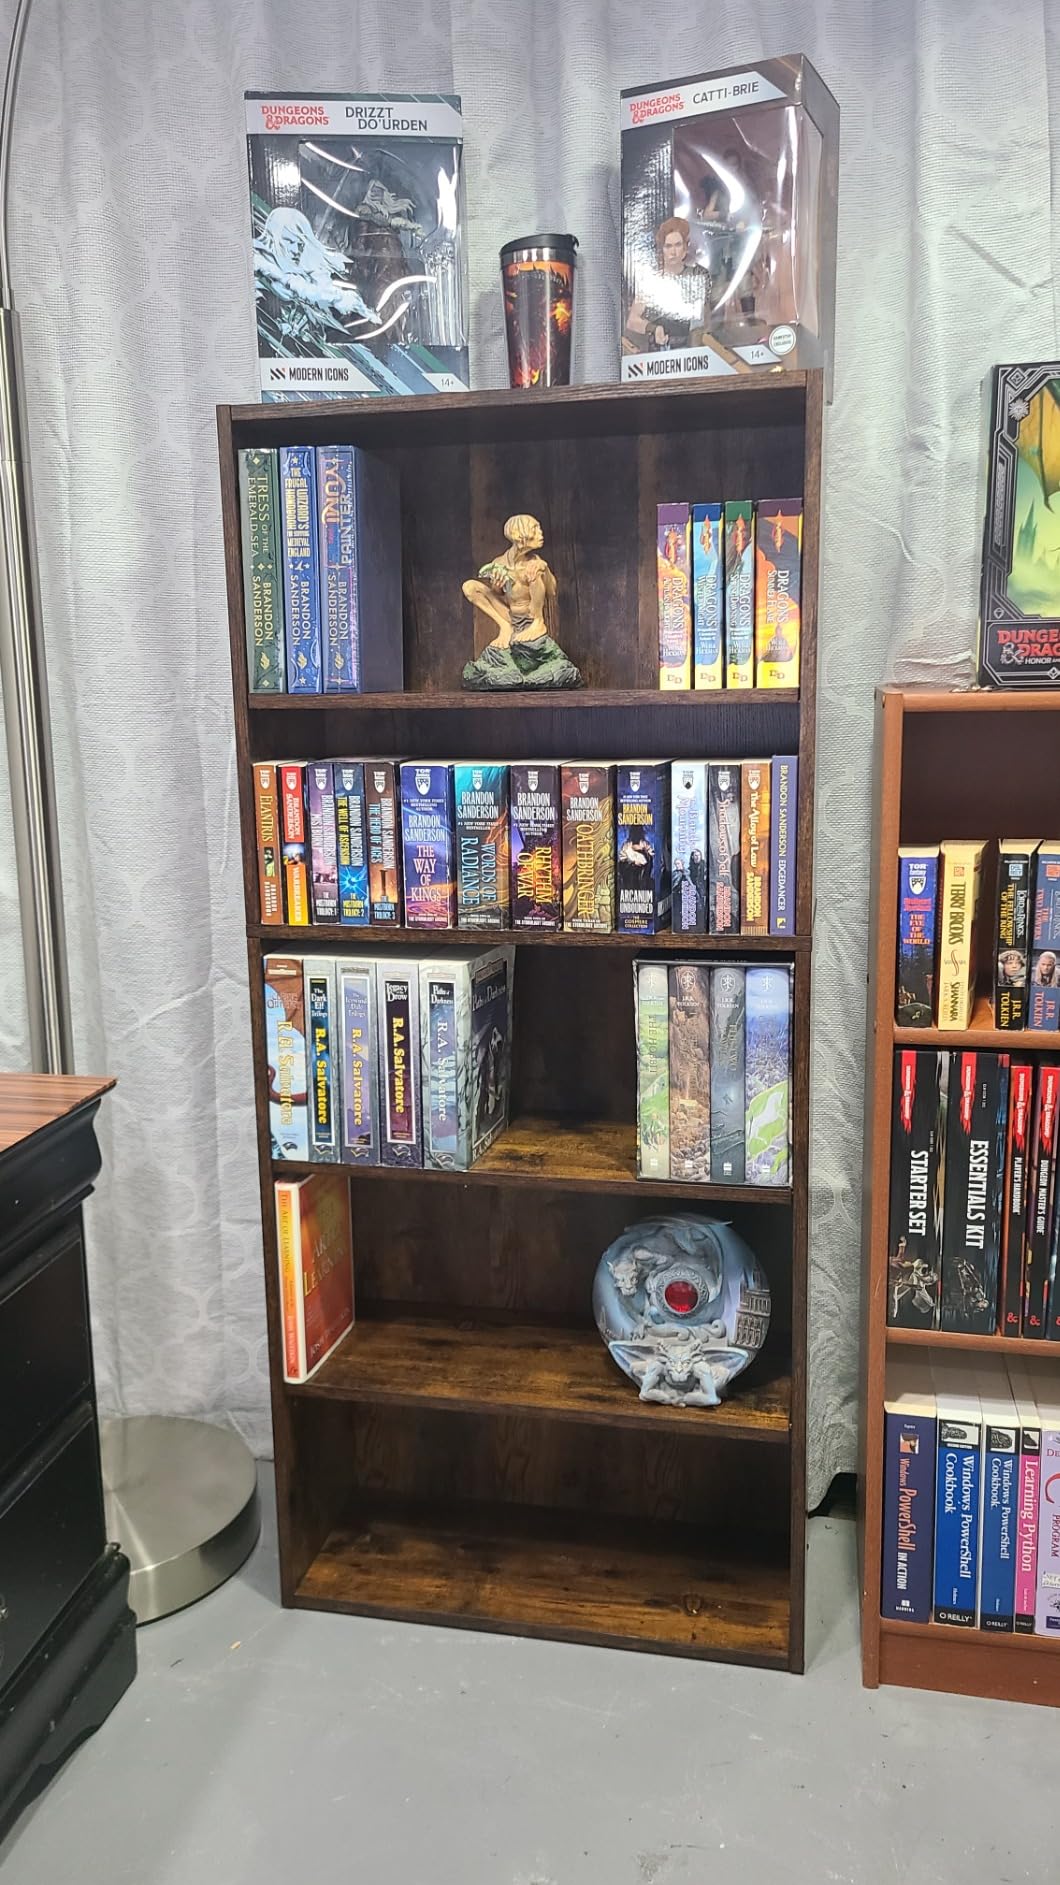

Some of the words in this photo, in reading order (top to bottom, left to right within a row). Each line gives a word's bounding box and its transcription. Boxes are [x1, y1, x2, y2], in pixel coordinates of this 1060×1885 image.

[629, 93, 681, 112] DUNGEONS
[693, 81, 760, 105] CATTI-BRIE
[261, 105, 325, 116] DUNGEONS
[345, 107, 394, 119] DRIZZT
[358, 118, 428, 131] DO'URDEN
[289, 367, 322, 381] MODERN
[324, 367, 349, 382] ICONS
[647, 358, 682, 377] MODERN
[684, 355, 709, 373] ICONS
[248, 477, 259, 532] EMERALD
[257, 474, 270, 521] TRESS
[322, 462, 346, 525] YUMI
[285, 488, 297, 530] HANDBOOK
[297, 488, 309, 530] WIZARD'S
[340, 494, 352, 564] PAINTER
[250, 534, 259, 558] SEA
[290, 575, 300, 646] SANDERSON
[300, 581, 311, 640] BRANDON
[672, 577, 684, 630] DRAGONS
[706, 574, 717, 627] DRAGONS
[740, 574, 751, 628] DRAGONS
[777, 569, 790, 623] DRAGONS
[252, 576, 263, 647] SANDERSON
[263, 582, 273, 640] BRANDON
[327, 575, 338, 647] SANDERSON
[338, 582, 348, 640] BRANDON
[997, 629, 1060, 643] DUNGE
[461, 791, 494, 805] BRANDON
[780, 765, 788, 802] BRANDON
[321, 795, 334, 826] BRANDON
[336, 796, 348, 808] THE
[349, 795, 362, 827] BRANDON
[369, 803, 380, 815] THE
[381, 797, 392, 829] BRANDON
[457, 806, 499, 819] SANDERSON
[513, 807, 555, 820] SANDERSON
[517, 792, 551, 806] BRANDON
[570, 797, 599, 809] BRANDON
[622, 804, 648, 815] BRANDON
[751, 792, 759, 807] The
[260, 795, 273, 842] ELANTRIS
[285, 794, 295, 839] SANDERSON
[337, 808, 349, 824] WELL
[339, 825, 349, 834] OF
[370, 816, 381, 834] HERO
[408, 815, 441, 828] BRANDON
[566, 809, 603, 822] SANDERSON
[617, 814, 653, 826] SANDERSON
[717, 799, 731, 842] Shadows
[748, 808, 761, 836] Alloy
[371, 836, 381, 845] OF
[405, 829, 446, 842] SANDERSON
[750, 836, 759, 845] of
[779, 804, 788, 857] SANDERSON
[323, 826, 336, 867] SANDERSON
[339, 834, 350, 865] ASCENSION
[351, 827, 363, 867] SANDERSON
[383, 830, 396, 870] SANDERSON
[417, 845, 435, 858] THE
[718, 843, 730, 855] of
[750, 846, 760, 868] Law
[414, 858, 436, 874] WAY
[461, 837, 480, 905] RADIANCE
[481, 843, 497, 883] WORDS
[518, 852, 534, 871] OF
[535, 847, 552, 903] RHYTHM
[576, 824, 595, 917] OATHBRINGER
[420, 874, 431, 886] OF
[482, 885, 497, 901] OF
[518, 871, 534, 898] WAR
[777, 859, 787, 911] EDGEDANCER
[1007, 883, 1015, 899] THE
[411, 888, 441, 902] KINGS
[619, 903, 653, 915] UNBOUNDED
[620, 889, 653, 903] ARCANUM
[746, 872, 755, 922] SANDERSON
[753, 876, 762, 918] BRANDON
[950, 881, 966, 910] TERRY
[1000, 891, 1007, 901] OF
[948, 911, 965, 946] BROOKS
[1006, 899, 1014, 946] FELLOWSHIP
[1017, 914, 1025, 936] RINGS
[311, 993, 327, 1002] Dark
[314, 1001, 325, 1010] Elf
[387, 991, 408, 1002] Drow
[950, 982, 961, 1022] SHANNARA
[1001, 992, 1010, 1027] TOLKIEN
[1011, 1000, 1022, 1021] J.R.R.
[1033, 992, 1043, 1027] TOLKIEN
[315, 1028, 327, 1056] R.A.
[352, 1028, 362, 1057] R.A.
[392, 1017, 404, 1047] R.A.
[437, 1022, 448, 1053] R.A.
[316, 1060, 327, 1124] Salvatore
[352, 1060, 363, 1126] Salvatore
[393, 1047, 405, 1114] Salvatore
[438, 1056, 449, 1122] Salvatore
[909, 1150, 929, 1212] STARTER
[965, 1140, 990, 1221] ESSENTIALS
[1013, 1156, 1022, 1182] PLAYER'S
[1039, 1159, 1049, 1186] DUNGEON
[1037, 1187, 1047, 1214] MASTER'S
[281, 1210, 289, 1223] ART
[908, 1214, 927, 1237] SET
[1036, 1215, 1046, 1235] GUIDE
[965, 1222, 986, 1250] KIT
[899, 1458, 910, 1487] Windows
[944, 1453, 958, 1514] Cookbook
[960, 1455, 975, 1512] Windows
[990, 1458, 1001, 1509] Cookbook
[1000, 1459, 1013, 1504] Windows
[1020, 1460, 1038, 1520] Learning
[897, 1488, 917, 1552] PowerShell
[1000, 1506, 1012, 1559] PowerShell
[959, 1513, 973, 1579] PowerShell
[1021, 1521, 1037, 1572] Python
[1050, 1513, 1060, 1558] PROGRAM
[898, 1551, 908, 1561] IN
[897, 1561, 908, 1590] ACTION
